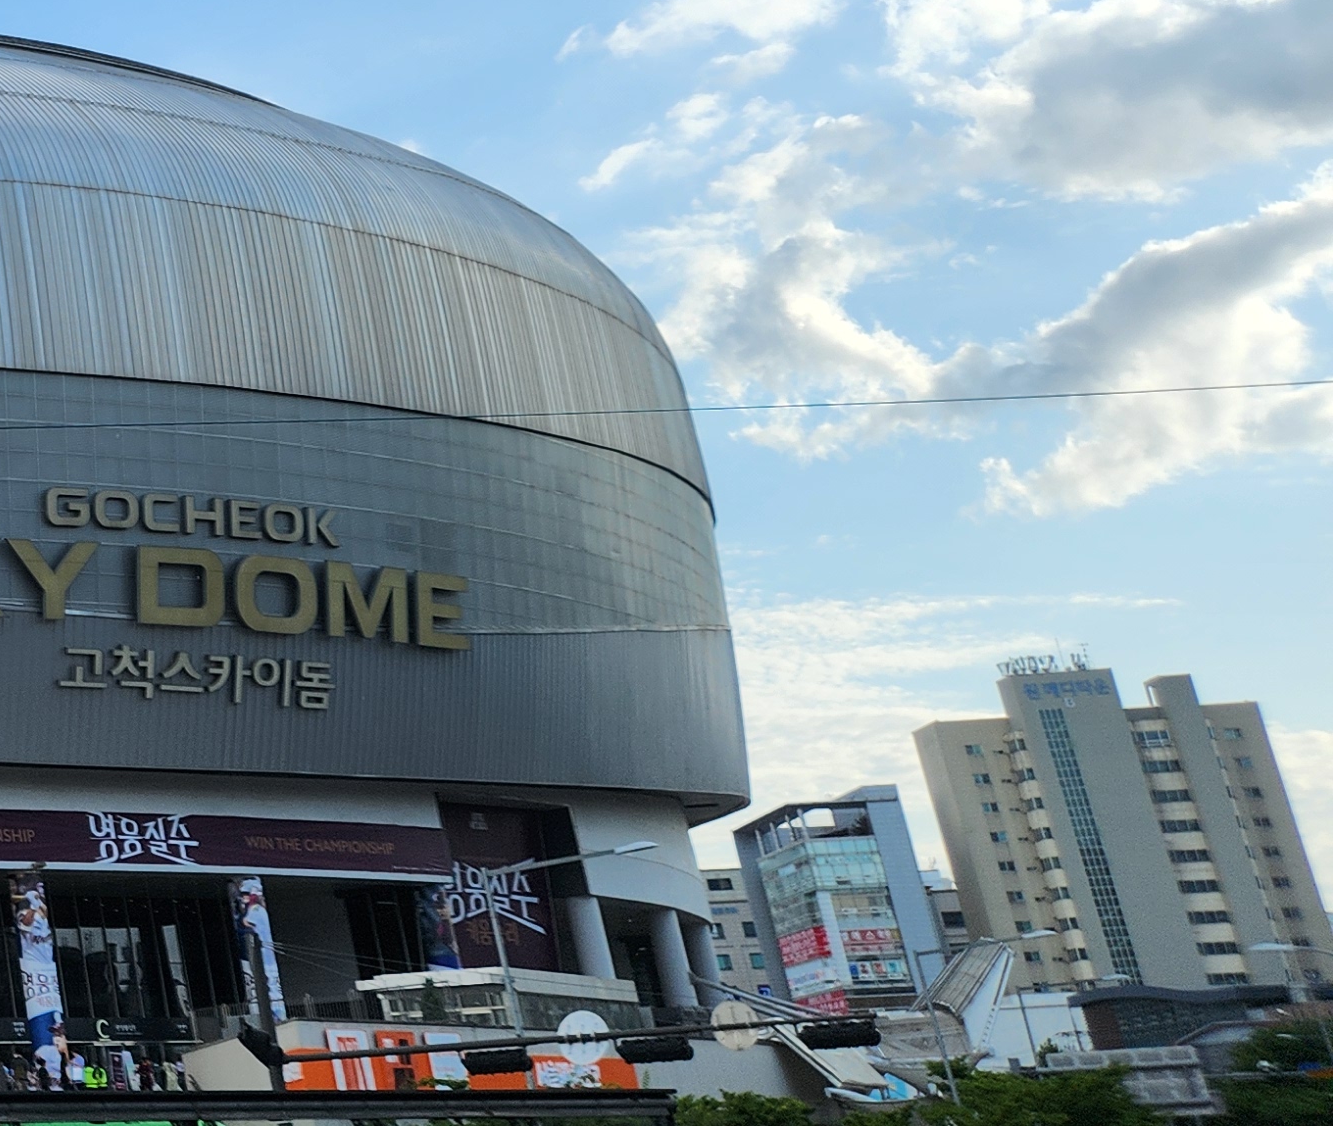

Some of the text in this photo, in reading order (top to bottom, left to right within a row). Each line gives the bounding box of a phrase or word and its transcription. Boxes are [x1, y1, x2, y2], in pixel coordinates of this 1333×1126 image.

[45, 485, 341, 548] GOCHEOK
[135, 544, 473, 651] DOME
[59, 644, 337, 711] 고척스카이돔
[244, 836, 395, 855] WIN THE CHAMPIONSHIP
[96, 1019, 110, 1039] C
